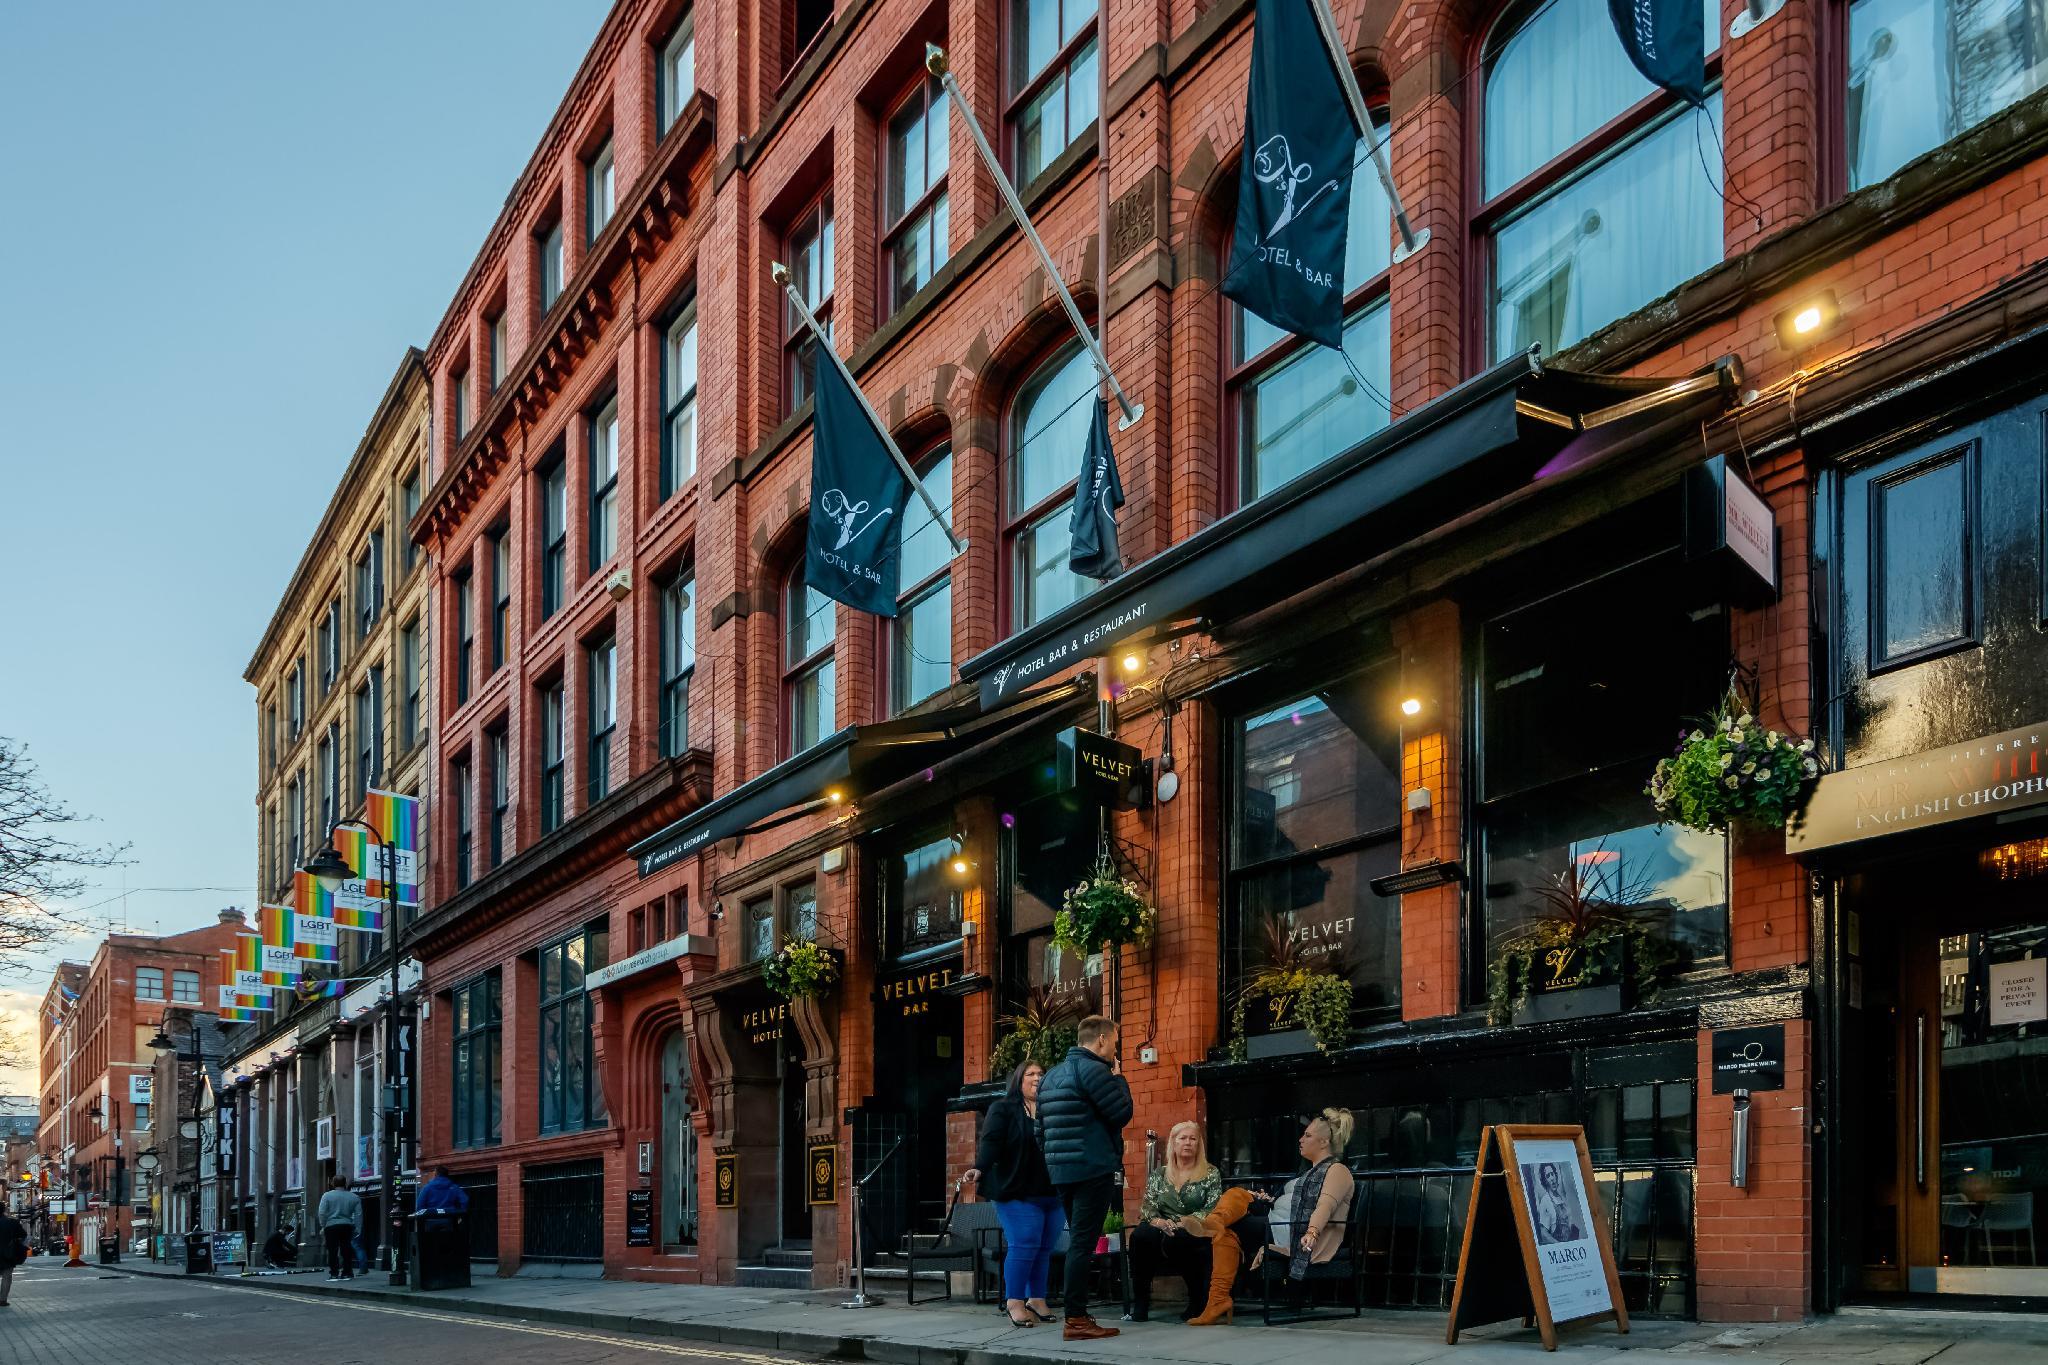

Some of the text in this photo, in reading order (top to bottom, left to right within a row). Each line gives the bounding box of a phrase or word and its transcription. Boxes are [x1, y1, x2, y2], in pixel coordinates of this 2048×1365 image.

[1255, 233, 1333, 288] OTEL & BAR
[820, 547, 882, 585] HOTEL & BAR
[1017, 656, 1046, 679] HOTEL
[1048, 645, 1067, 663] BAR
[1071, 639, 1079, 651] &
[1083, 603, 1147, 645] RESTAURANT
[1950, 734, 2039, 763] PIERRE
[1082, 750, 1132, 777] VELVET
[1856, 776, 2048, 829] ENGLISH CHOPH
[341, 882, 367, 894] LGB
[300, 919, 332, 931] LGBT
[1288, 917, 1355, 943] VELVET
[1328, 942, 1342, 951] BAR
[882, 969, 952, 1000] VELVET
[2001, 976, 2035, 986] CLOSED
[2006, 985, 2023, 993] FOR
[2000, 991, 2037, 1001] PRIVATE
[2005, 1000, 2032, 1008] EVENT
[743, 1002, 793, 1029] VELVET
[903, 1001, 929, 1016] BAR
[753, 1028, 783, 1044] HOTEL
[219, 1107, 234, 1171] KIKI
[1547, 1246, 1587, 1265] MARCO
